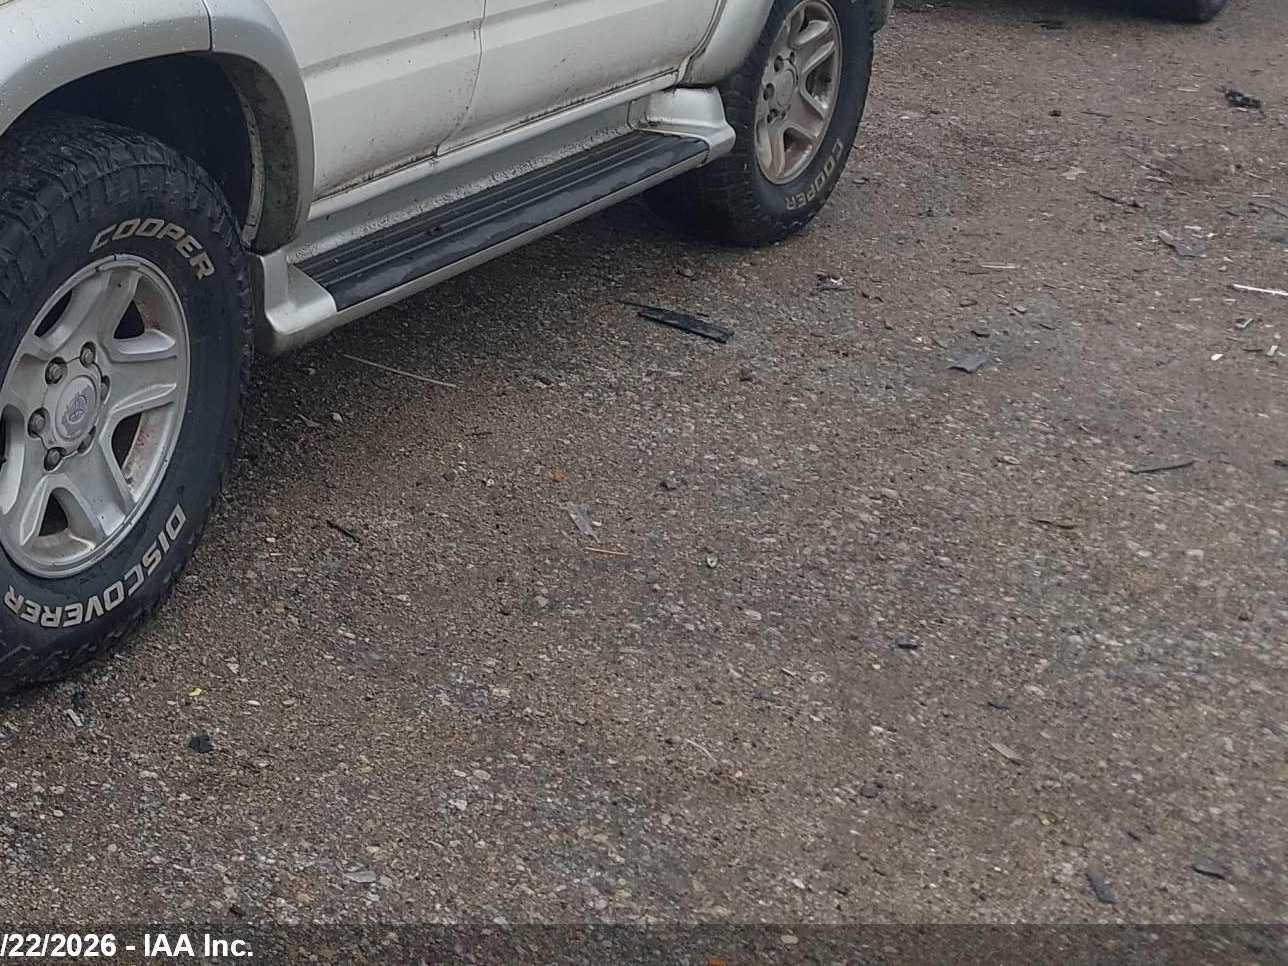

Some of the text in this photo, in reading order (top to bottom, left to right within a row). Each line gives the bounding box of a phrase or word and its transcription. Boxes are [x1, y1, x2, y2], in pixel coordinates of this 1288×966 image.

[785, 137, 844, 211] COOPER
[88, 217, 216, 281] COOPER
[3, 503, 187, 628] DISCOVERER
